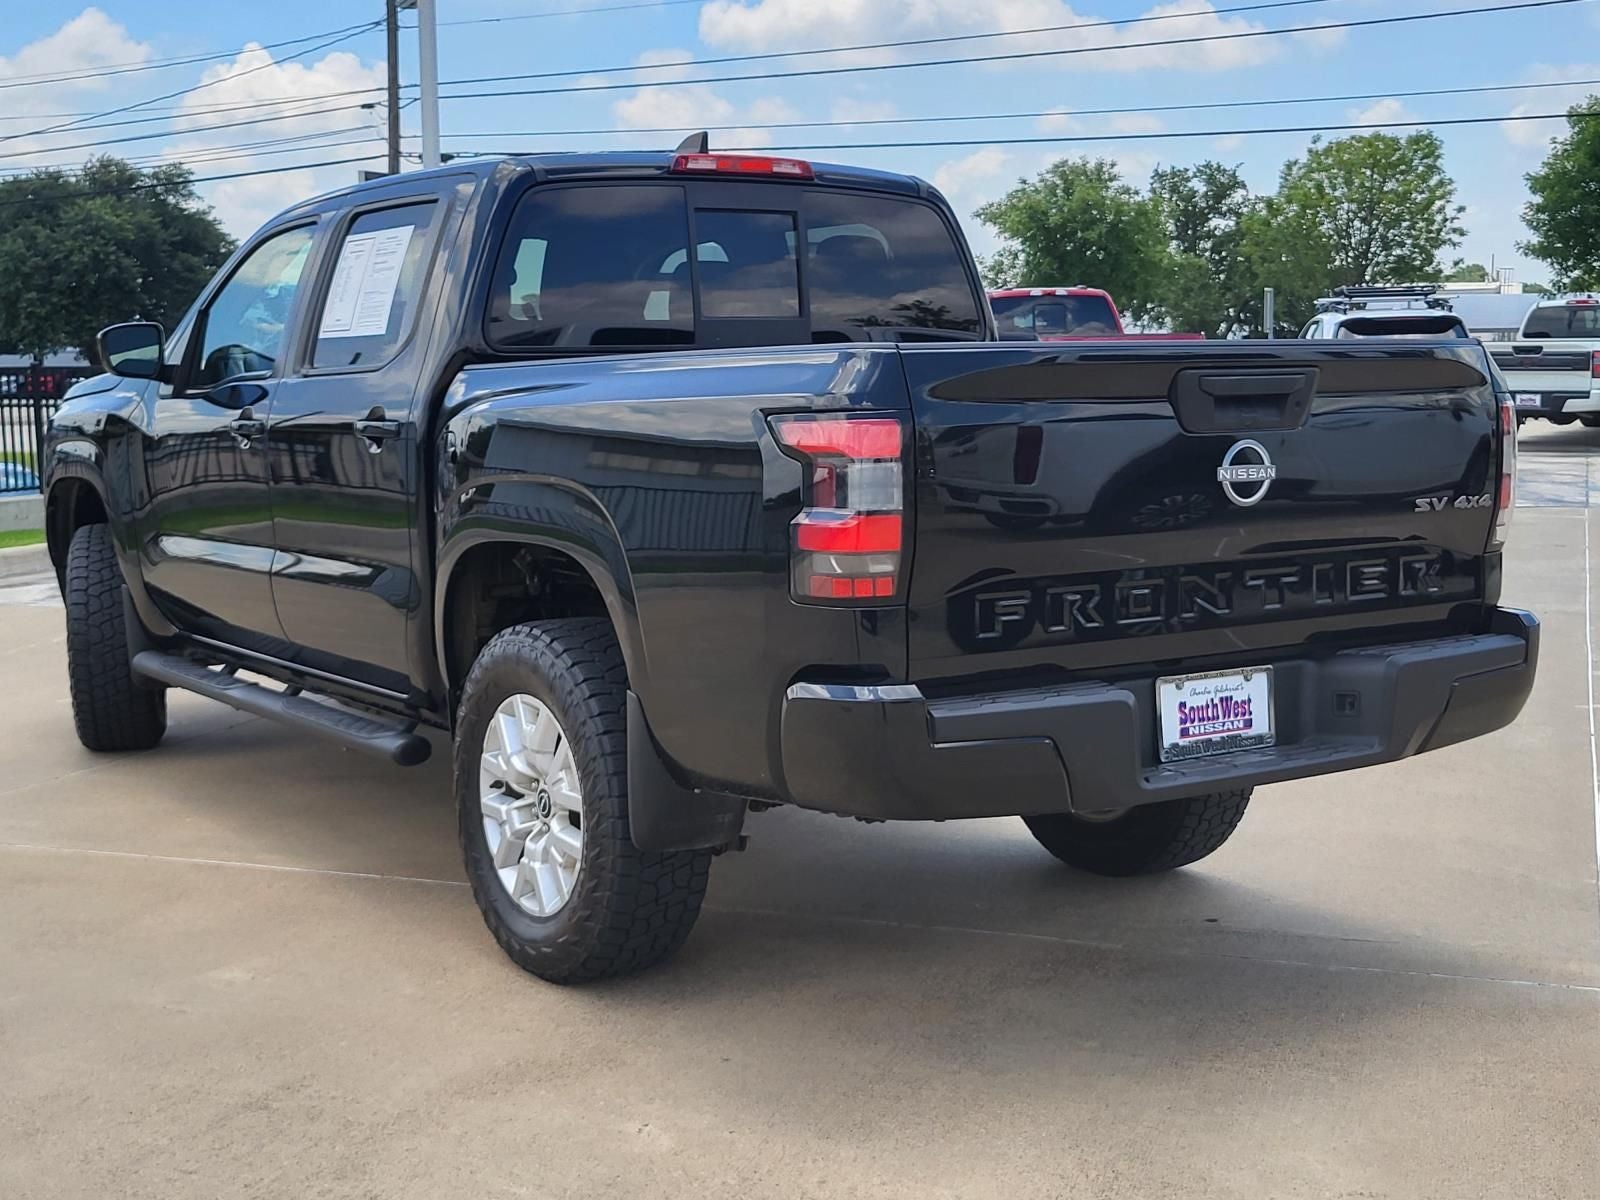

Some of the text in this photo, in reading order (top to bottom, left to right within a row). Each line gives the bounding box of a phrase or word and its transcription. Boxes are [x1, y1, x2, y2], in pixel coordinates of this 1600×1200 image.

[1218, 466, 1276, 480] NISSAN
[1414, 496, 1448, 512] SV
[974, 554, 1441, 639] FRONTIER
[1188, 720, 1243, 735] NISSAN
